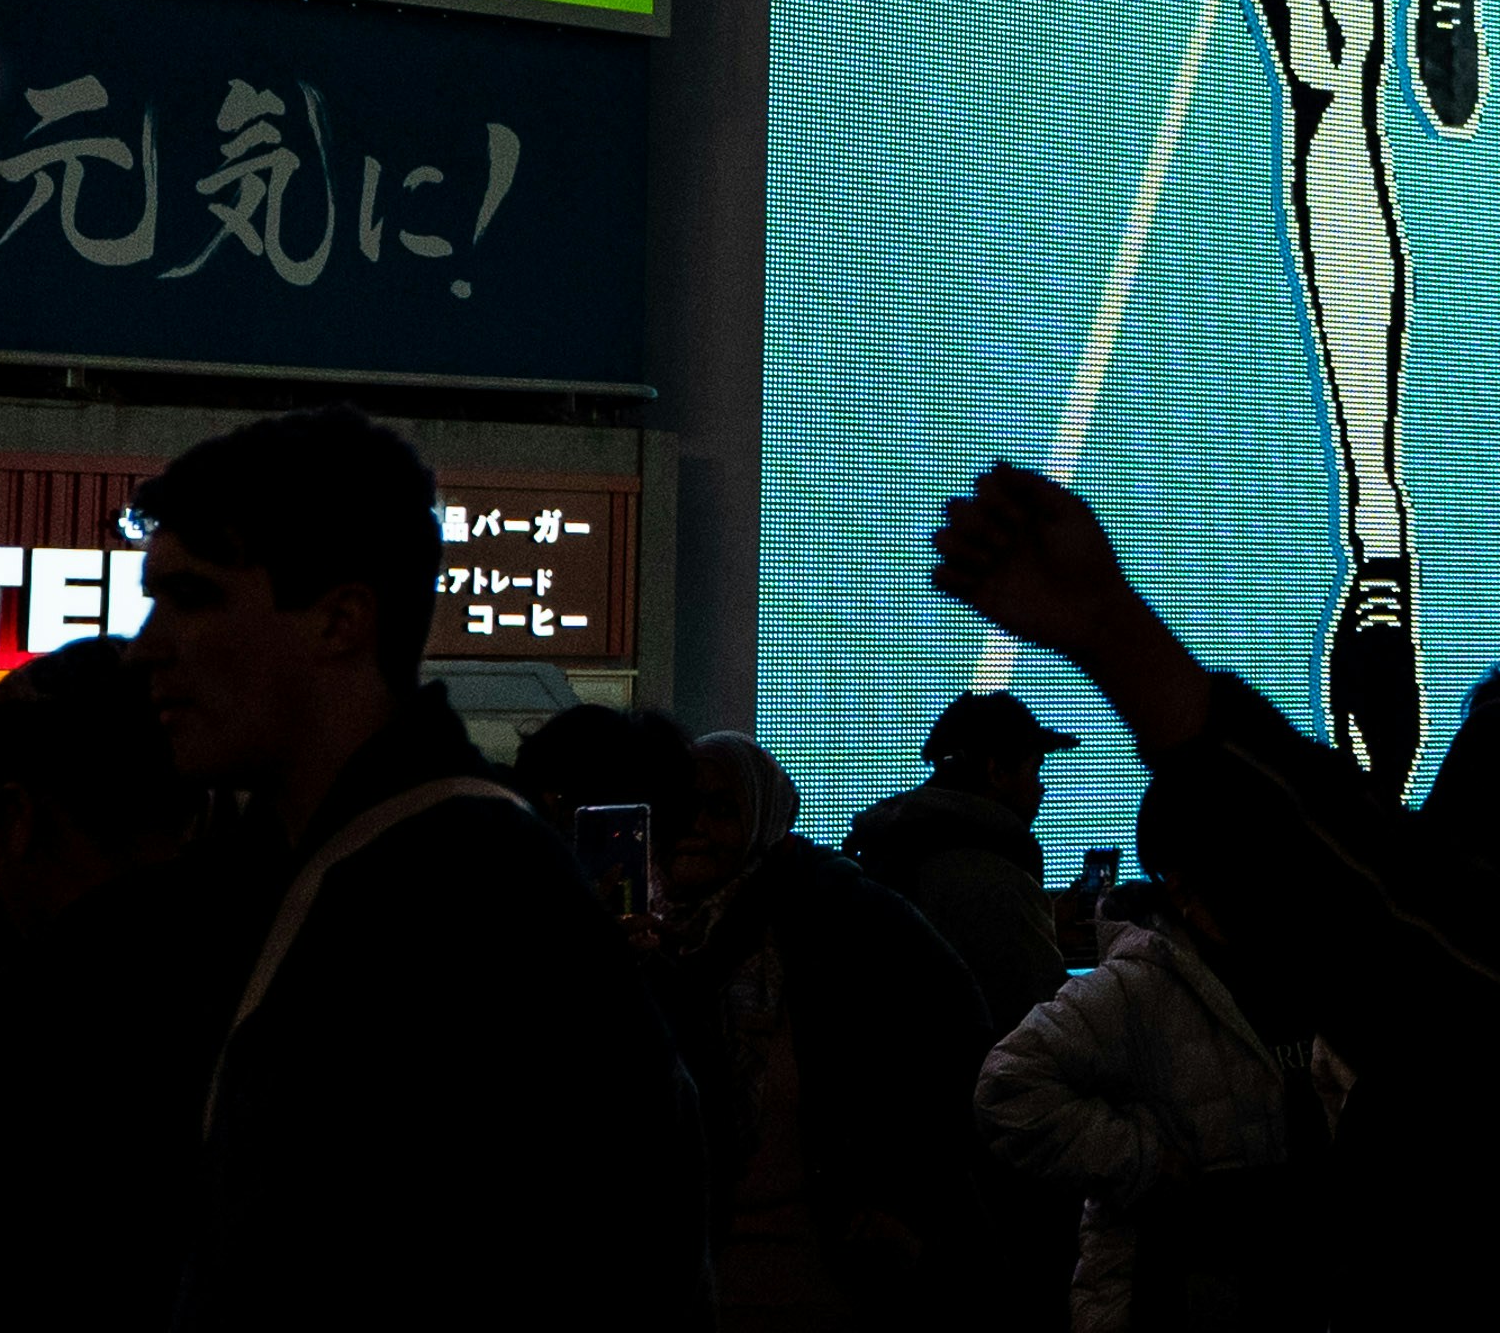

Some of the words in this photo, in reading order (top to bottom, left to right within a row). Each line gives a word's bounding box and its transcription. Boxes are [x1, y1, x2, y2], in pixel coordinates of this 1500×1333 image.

[430, 504, 591, 544] 品バーガー
[466, 602, 590, 637] コーヒー
